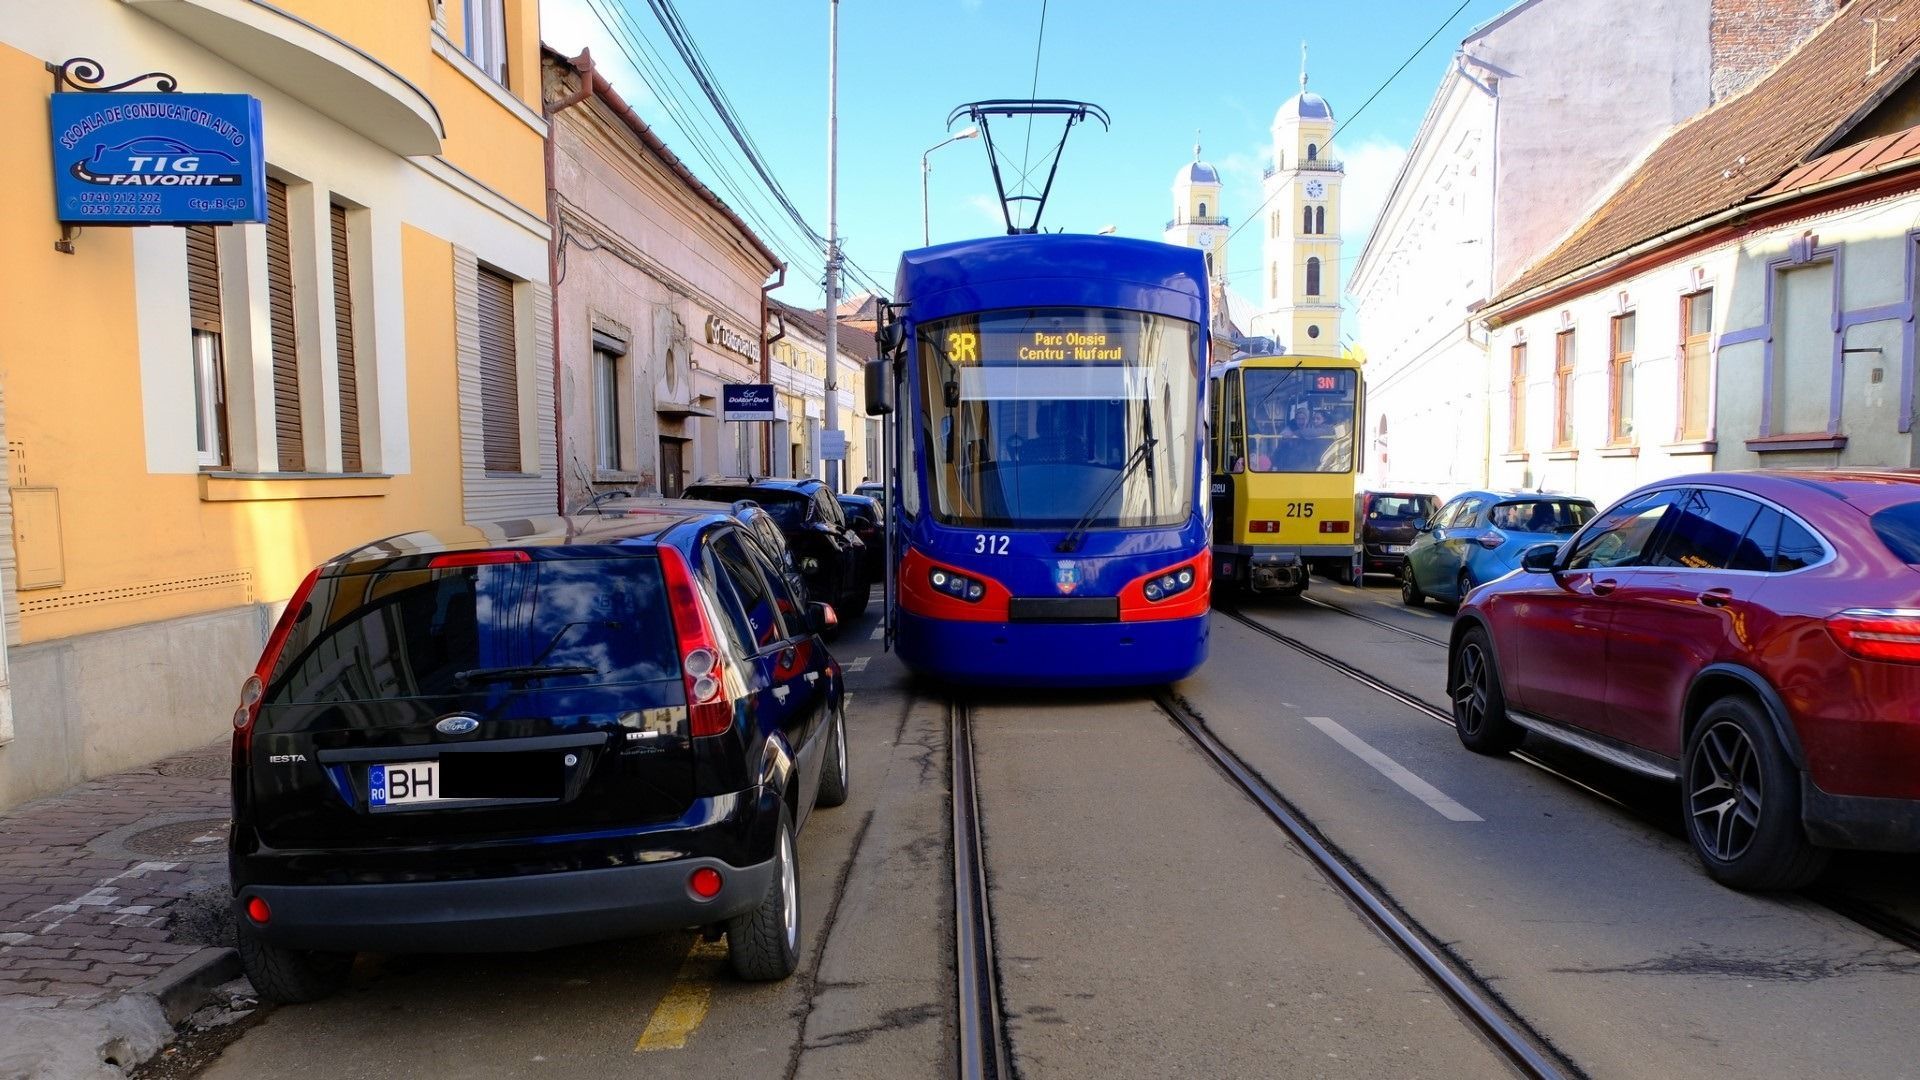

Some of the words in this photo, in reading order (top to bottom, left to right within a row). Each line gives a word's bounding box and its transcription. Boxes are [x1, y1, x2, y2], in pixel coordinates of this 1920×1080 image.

[60, 113, 105, 150] SCOALA
[106, 107, 122, 123] DE
[124, 102, 211, 126] CONDUCATORI
[210, 118, 246, 148] AUTO
[128, 157, 200, 172] TIG
[110, 174, 219, 186] FAVORIT
[80, 192, 111, 202] 0740
[113, 192, 136, 202] 912
[138, 192, 161, 202] 292
[80, 205, 111, 215] 0259
[114, 205, 136, 215] 226
[138, 205, 161, 215] 226
[1035, 333, 1062, 346] Parc
[1065, 332, 1106, 346] Olosig
[948, 332, 977, 362] 3R
[1019, 347, 1064, 360] Centru
[1074, 347, 1122, 360] Nufarul
[1317, 376, 1336, 389] 3N
[1286, 503, 1314, 518] 215
[974, 534, 1010, 555] 312
[388, 767, 433, 799] BH
[371, 788, 385, 800] RO
